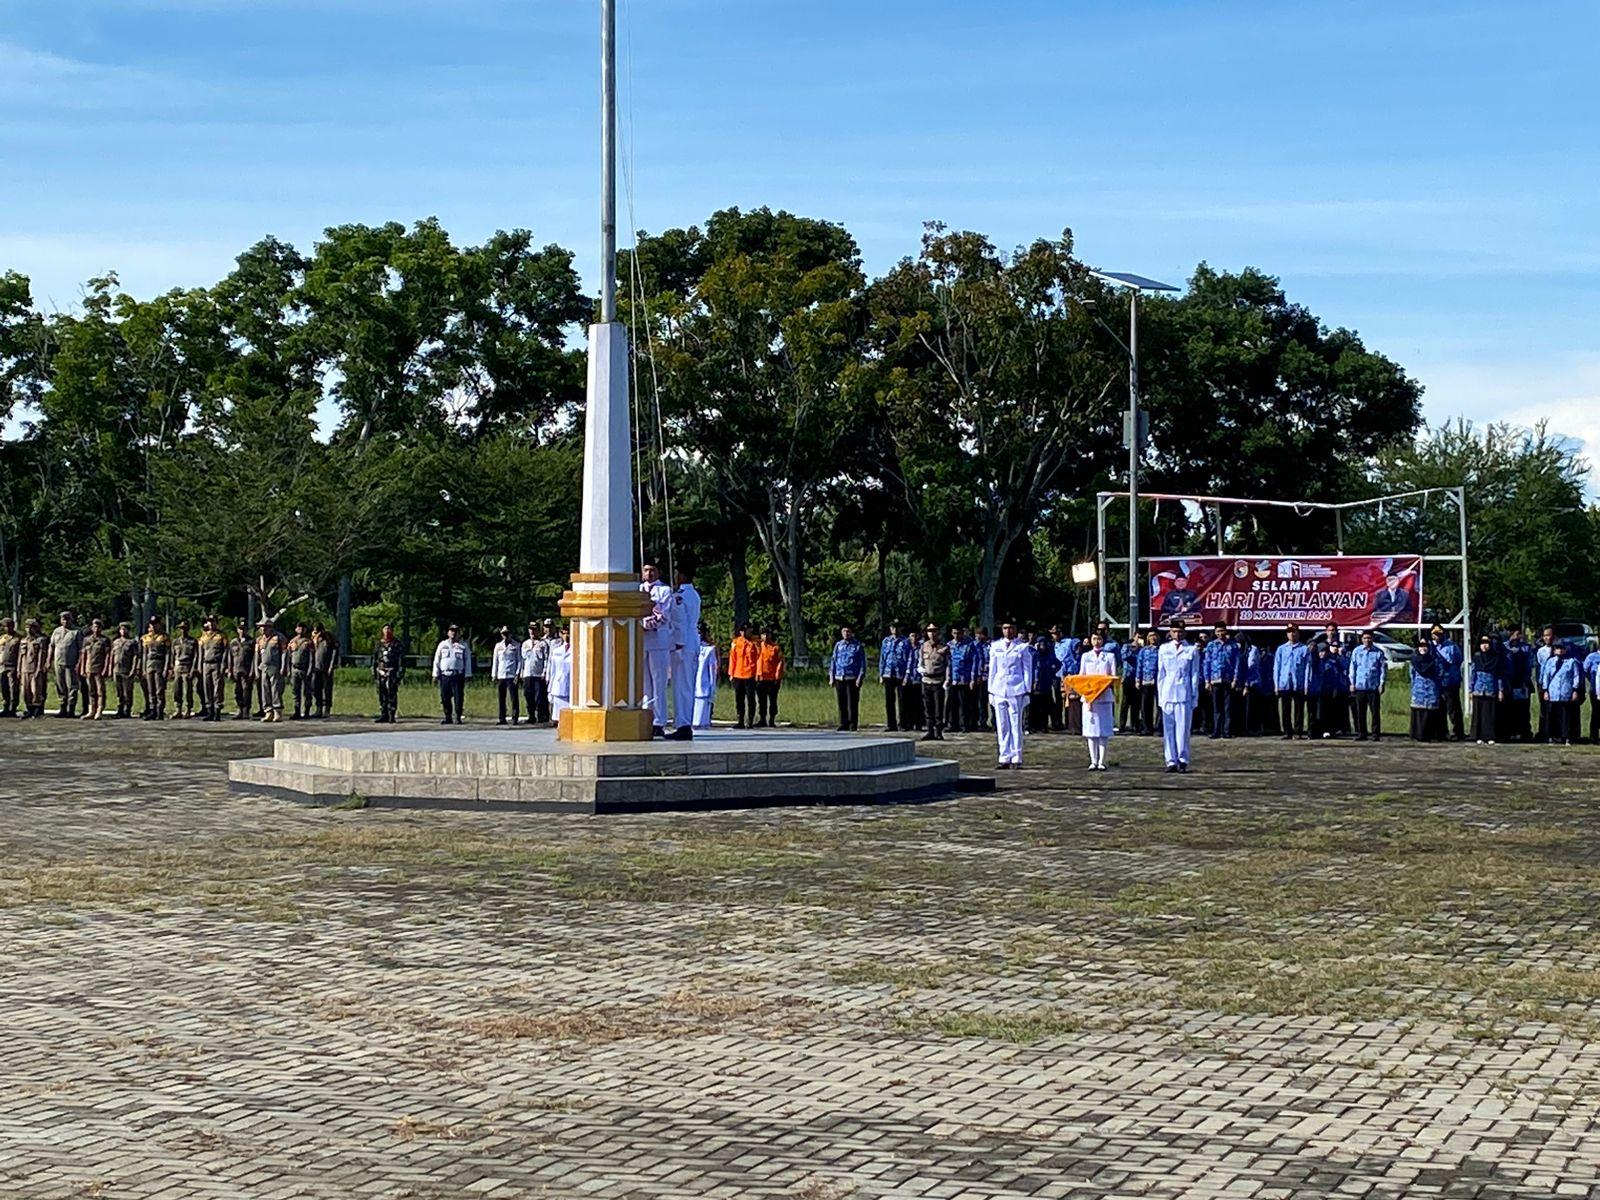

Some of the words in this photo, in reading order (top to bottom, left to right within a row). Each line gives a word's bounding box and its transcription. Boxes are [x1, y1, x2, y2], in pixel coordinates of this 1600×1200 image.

[1252, 580, 1320, 591] SELAMAT
[1205, 592, 1254, 609] HARI
[1257, 592, 1368, 609] PAHLAWAN
[1240, 610, 1252, 620] 10
[1253, 611, 1306, 620] NOVEMBER
